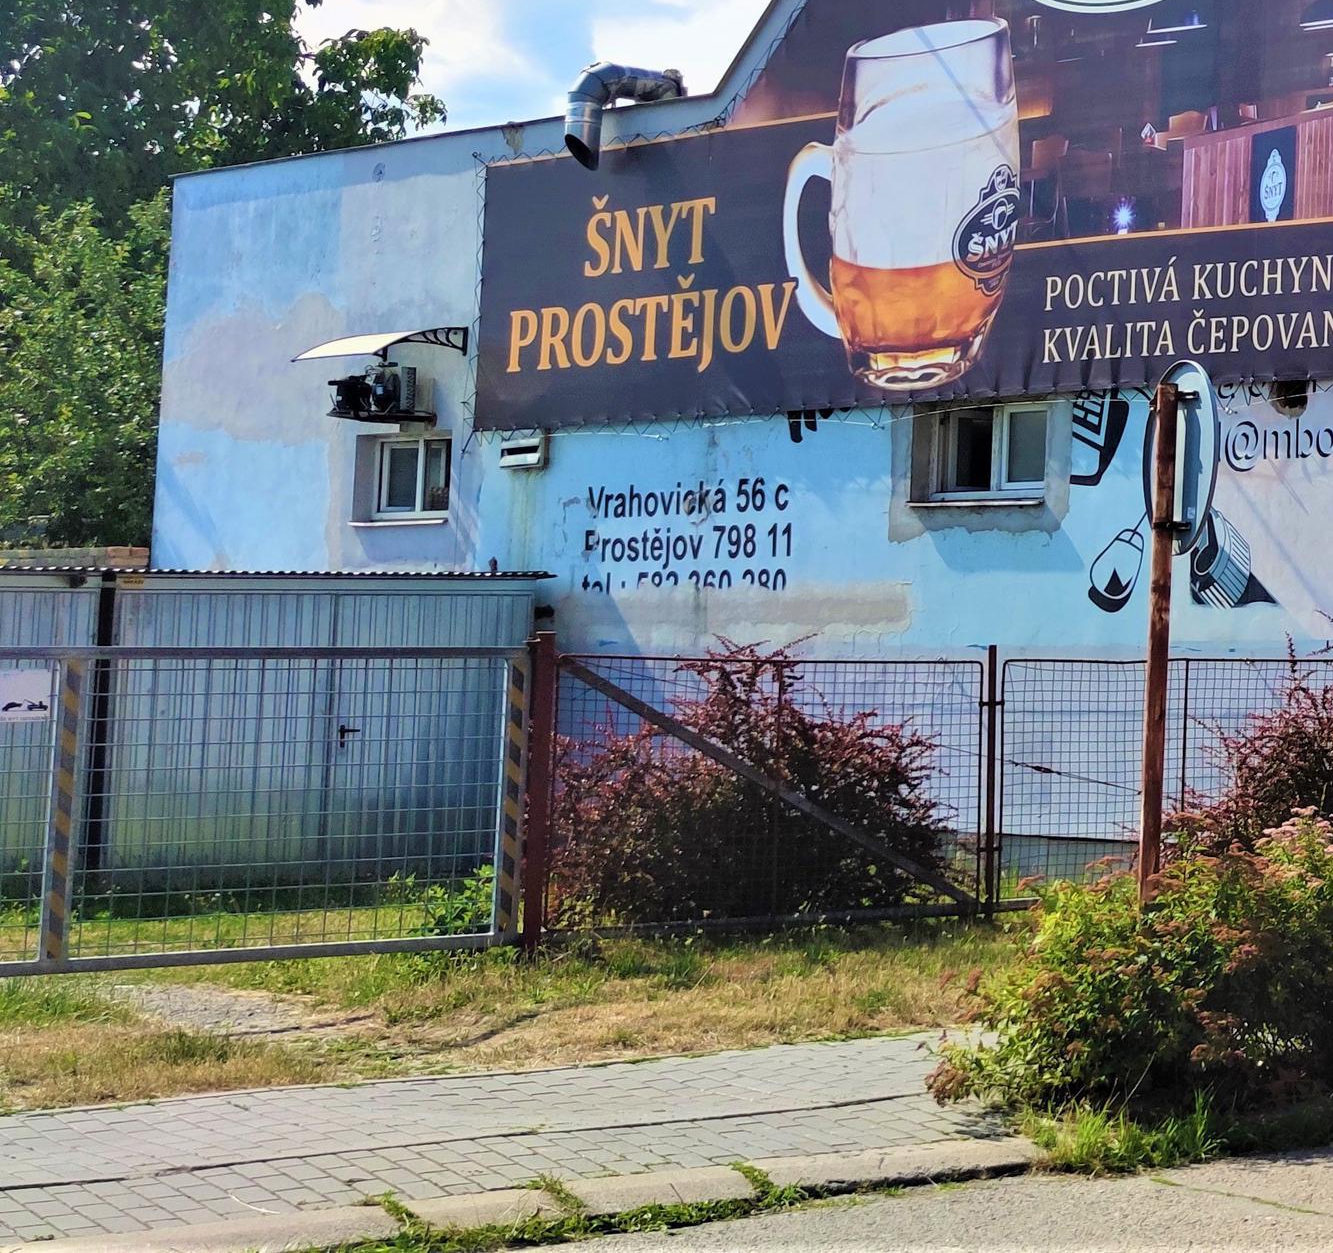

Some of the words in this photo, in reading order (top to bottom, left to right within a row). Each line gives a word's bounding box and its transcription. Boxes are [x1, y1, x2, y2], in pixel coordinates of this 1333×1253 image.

[584, 193, 716, 277] ŠNYT
[1044, 256, 1180, 311] POCTIVÁ
[506, 273, 798, 373] PROSTĚJOV
[1042, 320, 1176, 364] KVALITA
[588, 479, 726, 519] Vrahovická
[736, 477, 765, 513] 56
[775, 483, 789, 512] c
[713, 523, 756, 559] 798
[768, 522, 792, 557] 11
